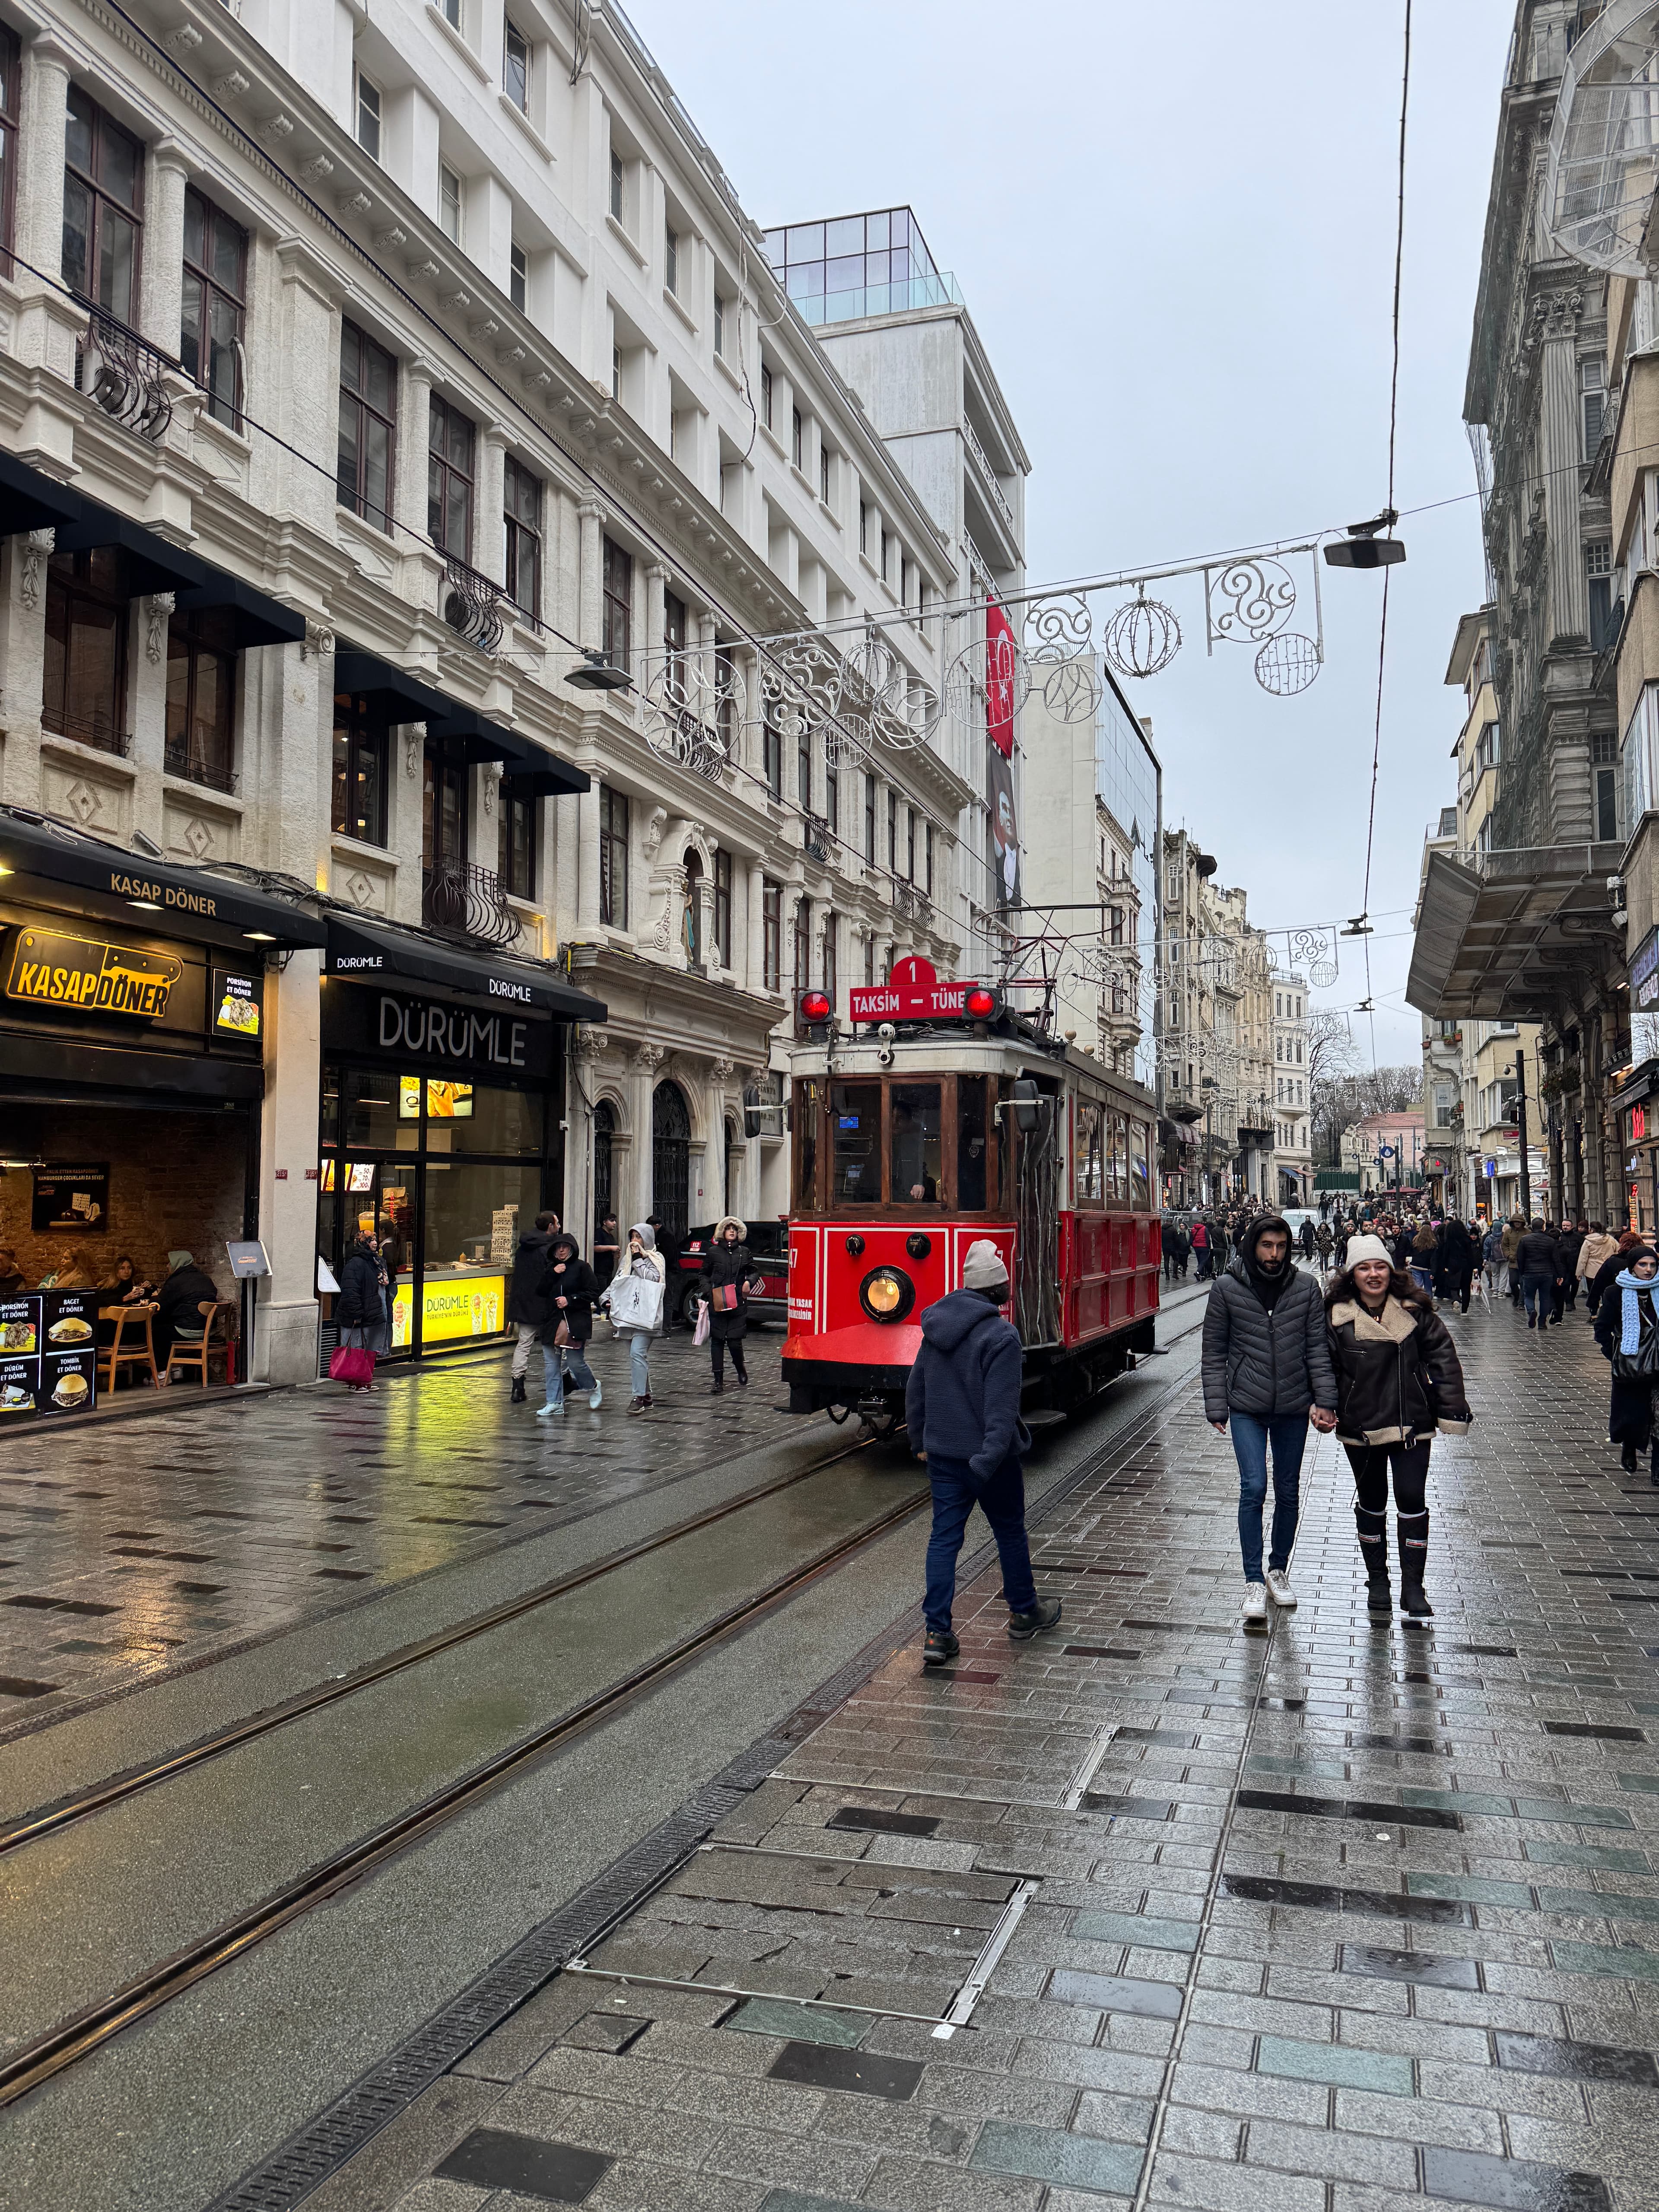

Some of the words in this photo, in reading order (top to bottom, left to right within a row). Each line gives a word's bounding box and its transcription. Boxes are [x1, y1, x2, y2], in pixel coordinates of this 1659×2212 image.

[111, 873, 161, 901] KASAP
[165, 887, 216, 916] DÖNER
[337, 957, 383, 969] DÜRÜMLE
[909, 961, 916, 983] 1
[227, 977, 251, 988] PORSİYON
[234, 987, 251, 997] DÖNER
[489, 978, 531, 1003] DÜRÜMLE
[853, 990, 899, 1013] TAKSİM
[931, 988, 966, 1010] TÜNE
[379, 996, 527, 1066] DÜRÜMLE
[427, 1295, 469, 1313] DÜRÜMLE
[796, 1298, 813, 1308] YASAK
[427, 1311, 452, 1321] TÜRKİYE'NİN
[60, 1356, 79, 1365] TOMBİK
[4, 1363, 24, 1373] DÜRÜM
[8, 1372, 27, 1381] DÖNER
